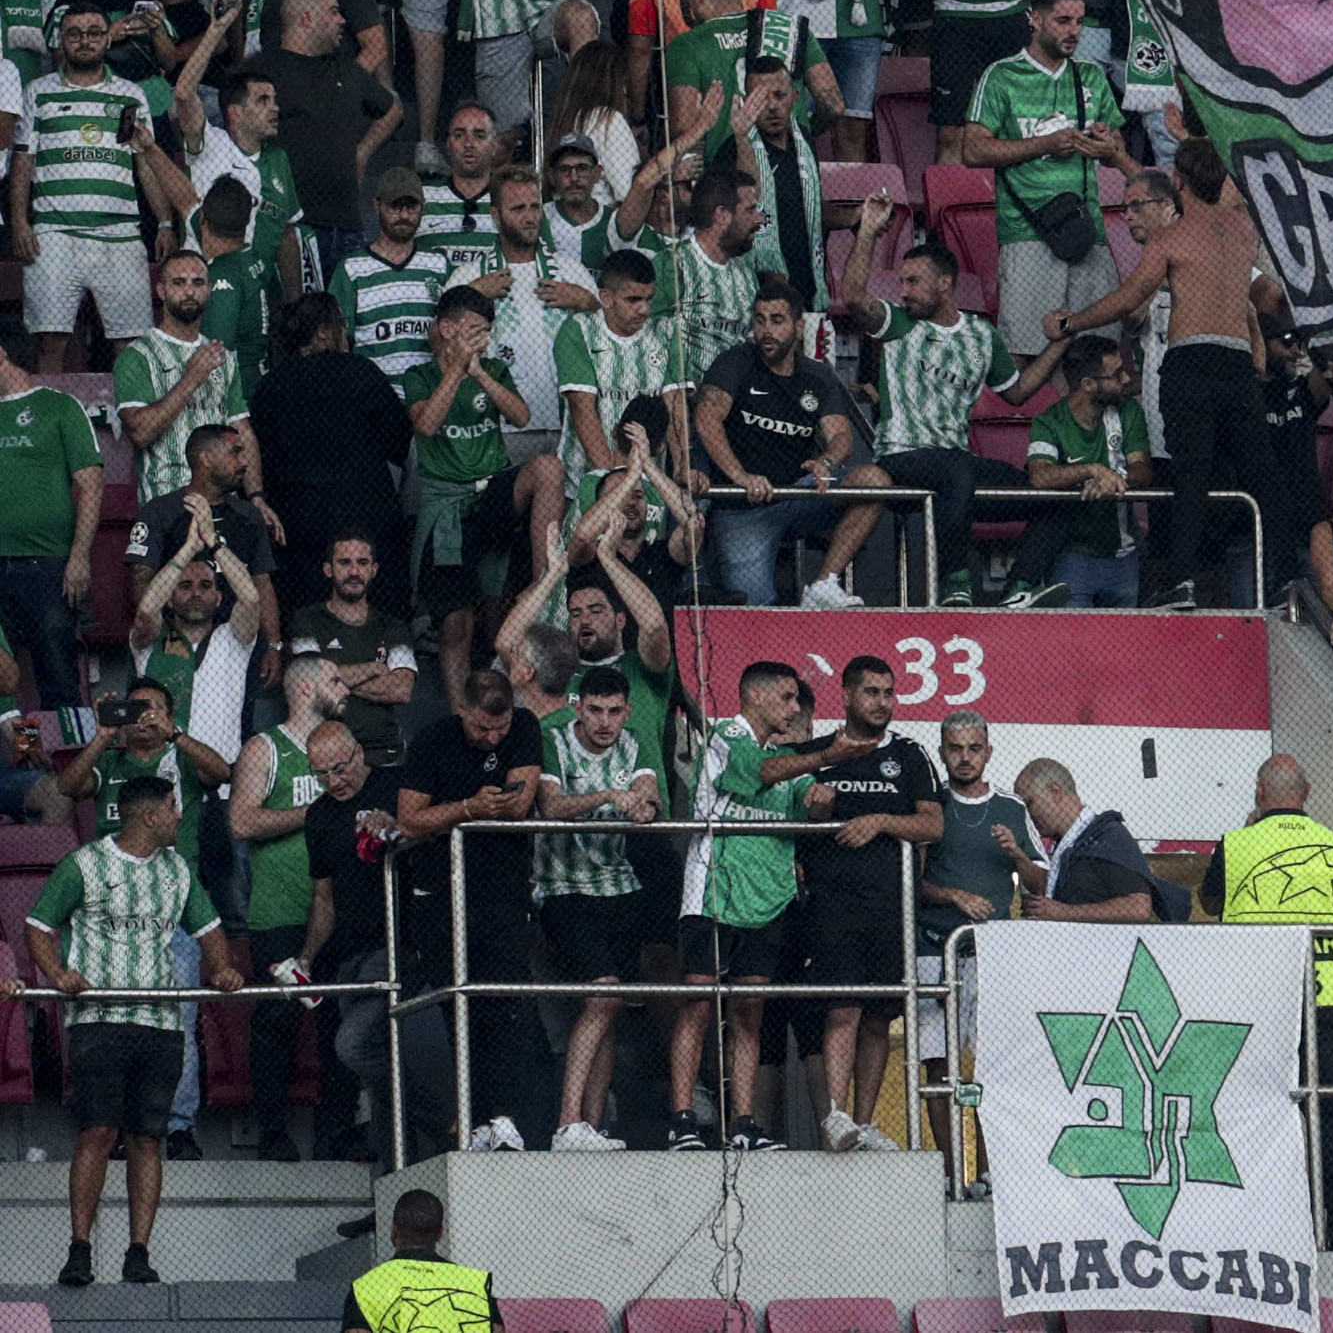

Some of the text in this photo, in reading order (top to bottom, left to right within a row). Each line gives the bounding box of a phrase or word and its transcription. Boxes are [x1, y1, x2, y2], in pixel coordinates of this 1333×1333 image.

[64, 146, 116, 163] dafabet
[740, 410, 813, 438] VOLVO
[894, 635, 988, 706] 33
[104, 917, 177, 933] VOLVO
[1005, 1238, 1313, 1315] MACCABI
